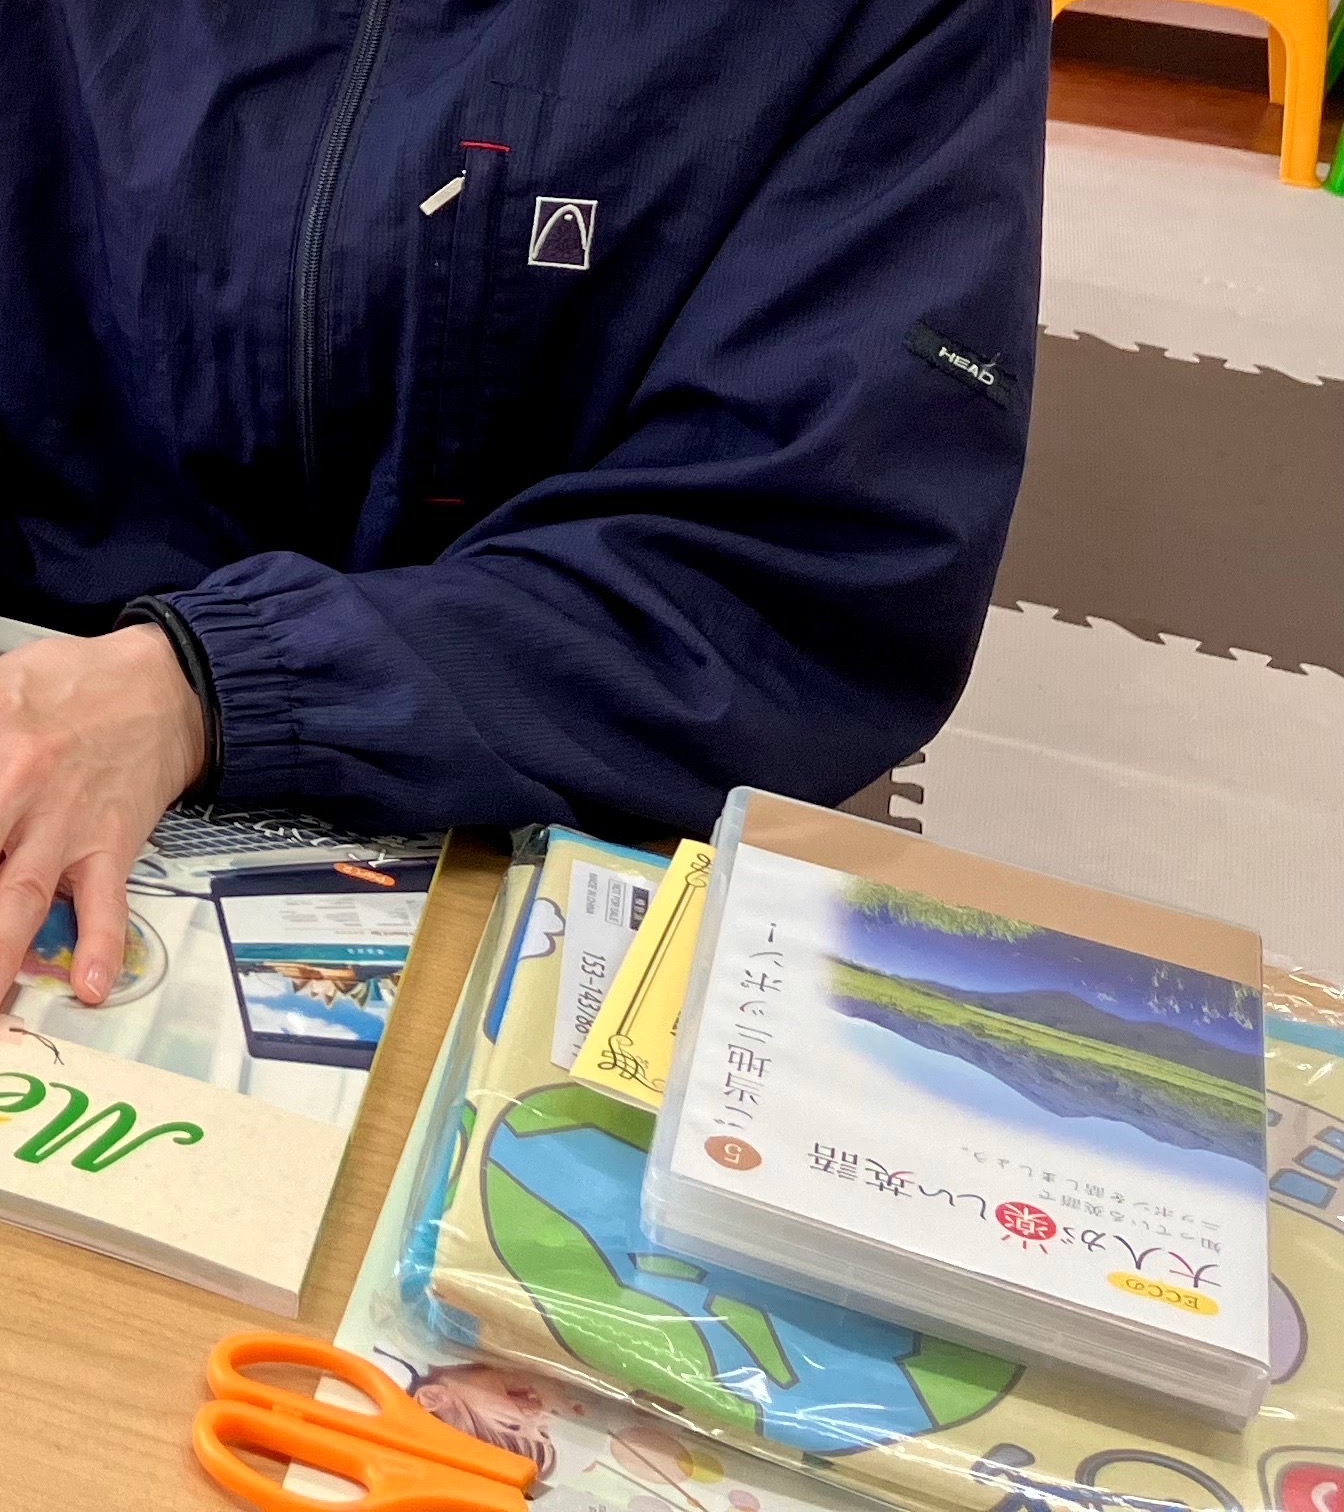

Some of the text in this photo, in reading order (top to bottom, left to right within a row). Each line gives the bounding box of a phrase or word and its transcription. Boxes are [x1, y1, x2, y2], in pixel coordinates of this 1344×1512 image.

[938, 345, 995, 386] HEAD
[360, 869, 388, 885] Part
[723, 1143, 742, 1165] 5
[807, 1142, 1222, 1288] 大人が楽しい英語
[1037, 1189, 1222, 1253] 知っている英語で
[1124, 1277, 1200, 1310] ECCの
